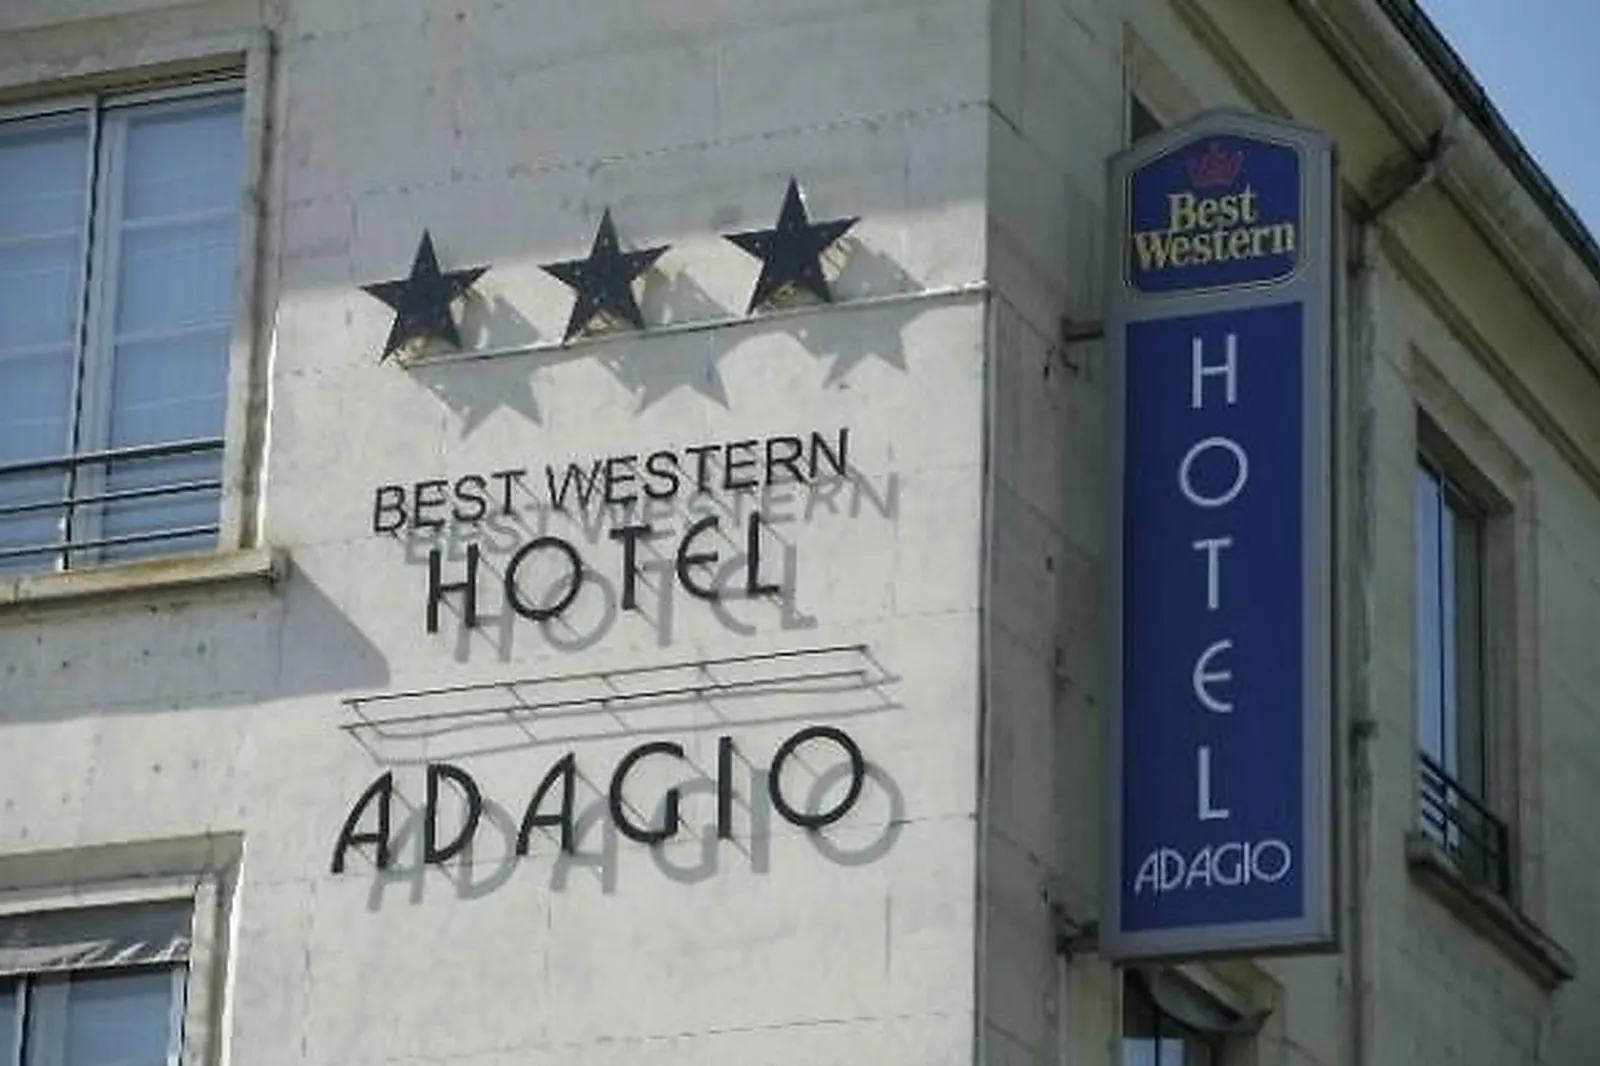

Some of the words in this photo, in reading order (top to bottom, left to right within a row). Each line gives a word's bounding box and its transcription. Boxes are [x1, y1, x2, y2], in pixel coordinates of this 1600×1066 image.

[1134, 221, 1295, 271] Western
[1166, 181, 1257, 232] Best
[373, 469, 528, 533] BEST
[547, 428, 849, 510] WESTERN
[426, 512, 780, 634] HOTEL
[1178, 333, 1249, 821] HOTEL
[331, 726, 864, 875] ADAGIO
[1134, 839, 1292, 896] ADAGIO
